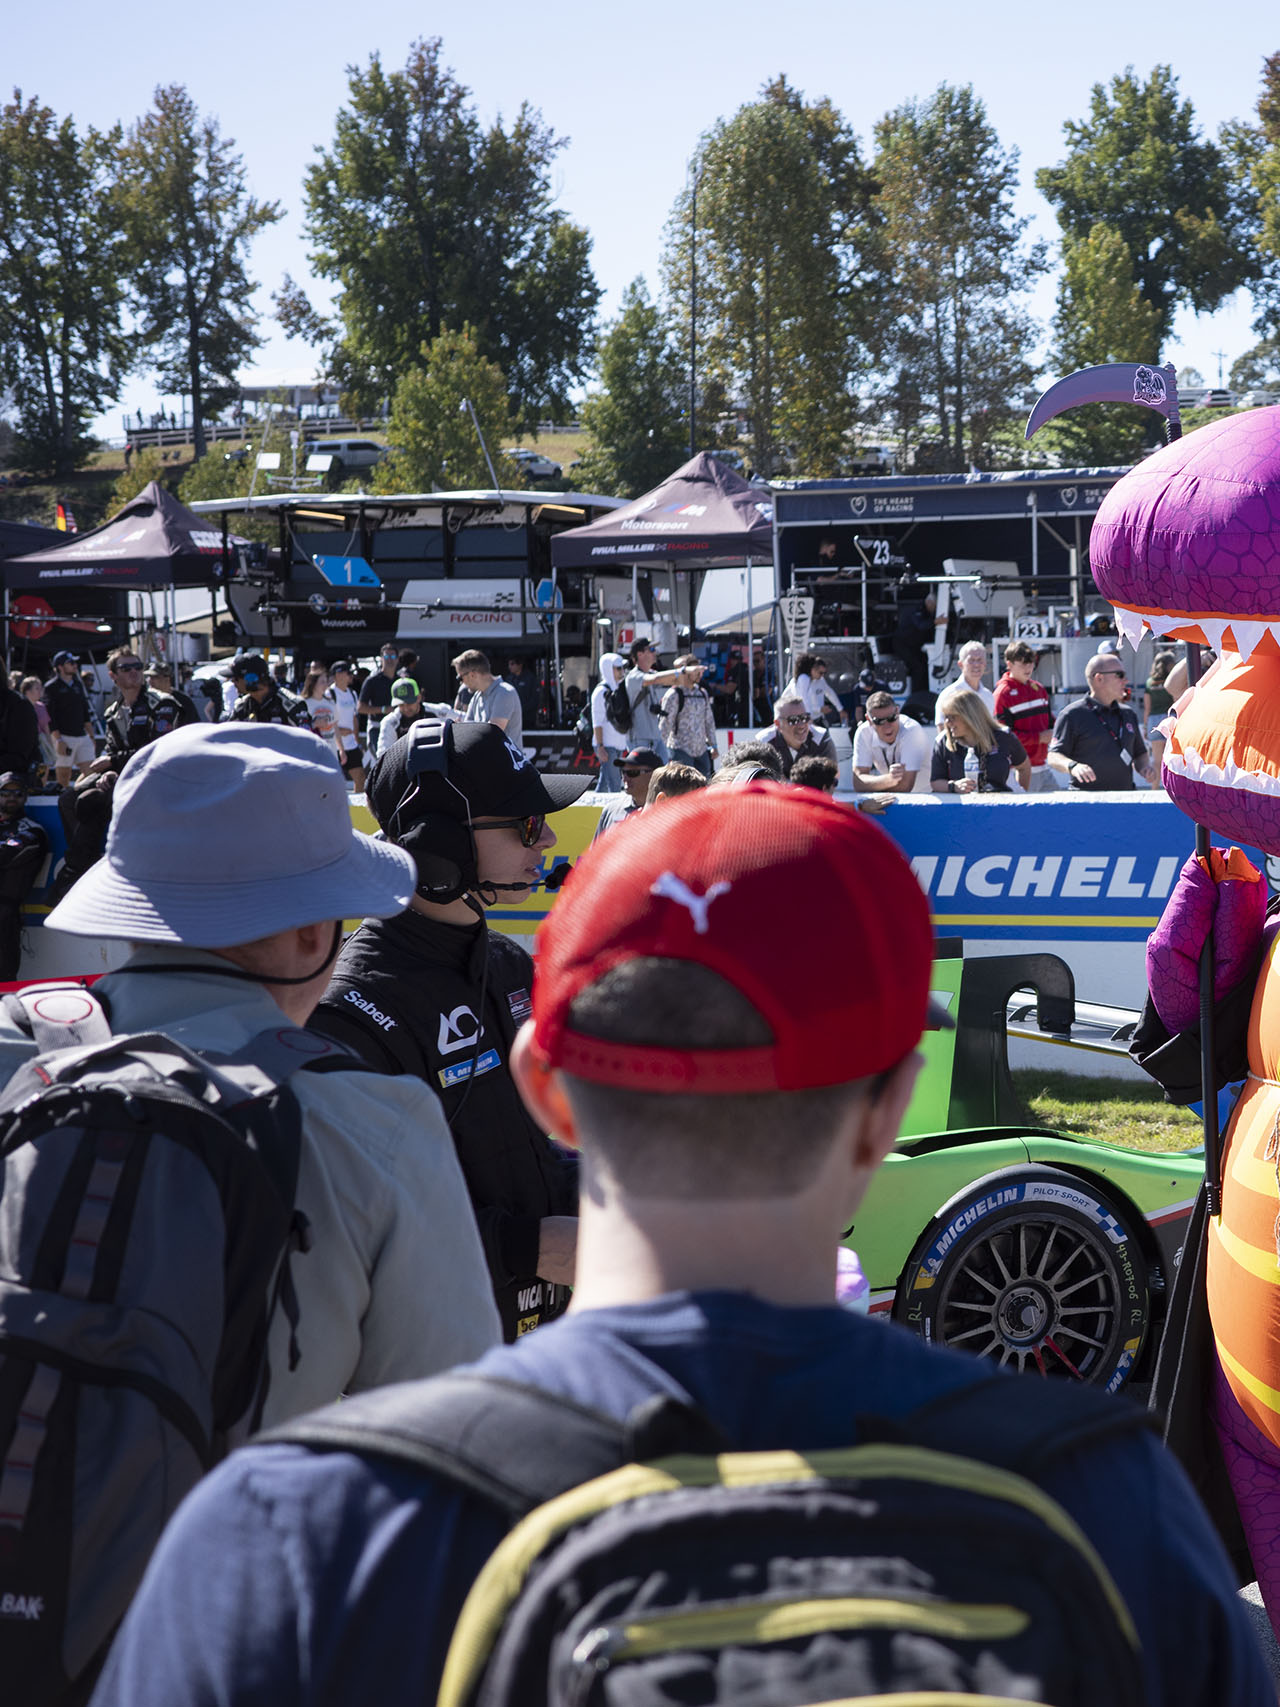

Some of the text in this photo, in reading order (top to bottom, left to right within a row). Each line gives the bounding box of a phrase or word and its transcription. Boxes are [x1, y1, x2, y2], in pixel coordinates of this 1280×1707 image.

[620, 519, 689, 531] Motorsport
[591, 542, 709, 556] PAUL MILLER RACING
[873, 540, 890, 564] 23
[343, 559, 352, 584] 1
[449, 613, 513, 624] RACING
[1020, 623, 1041, 638] 23
[908, 855, 1180, 898] ICHELI
[343, 990, 398, 1032] Sabelt
[1032, 1186, 1092, 1209] PILOT SPORT
[936, 1187, 1020, 1256] MICHELIN
